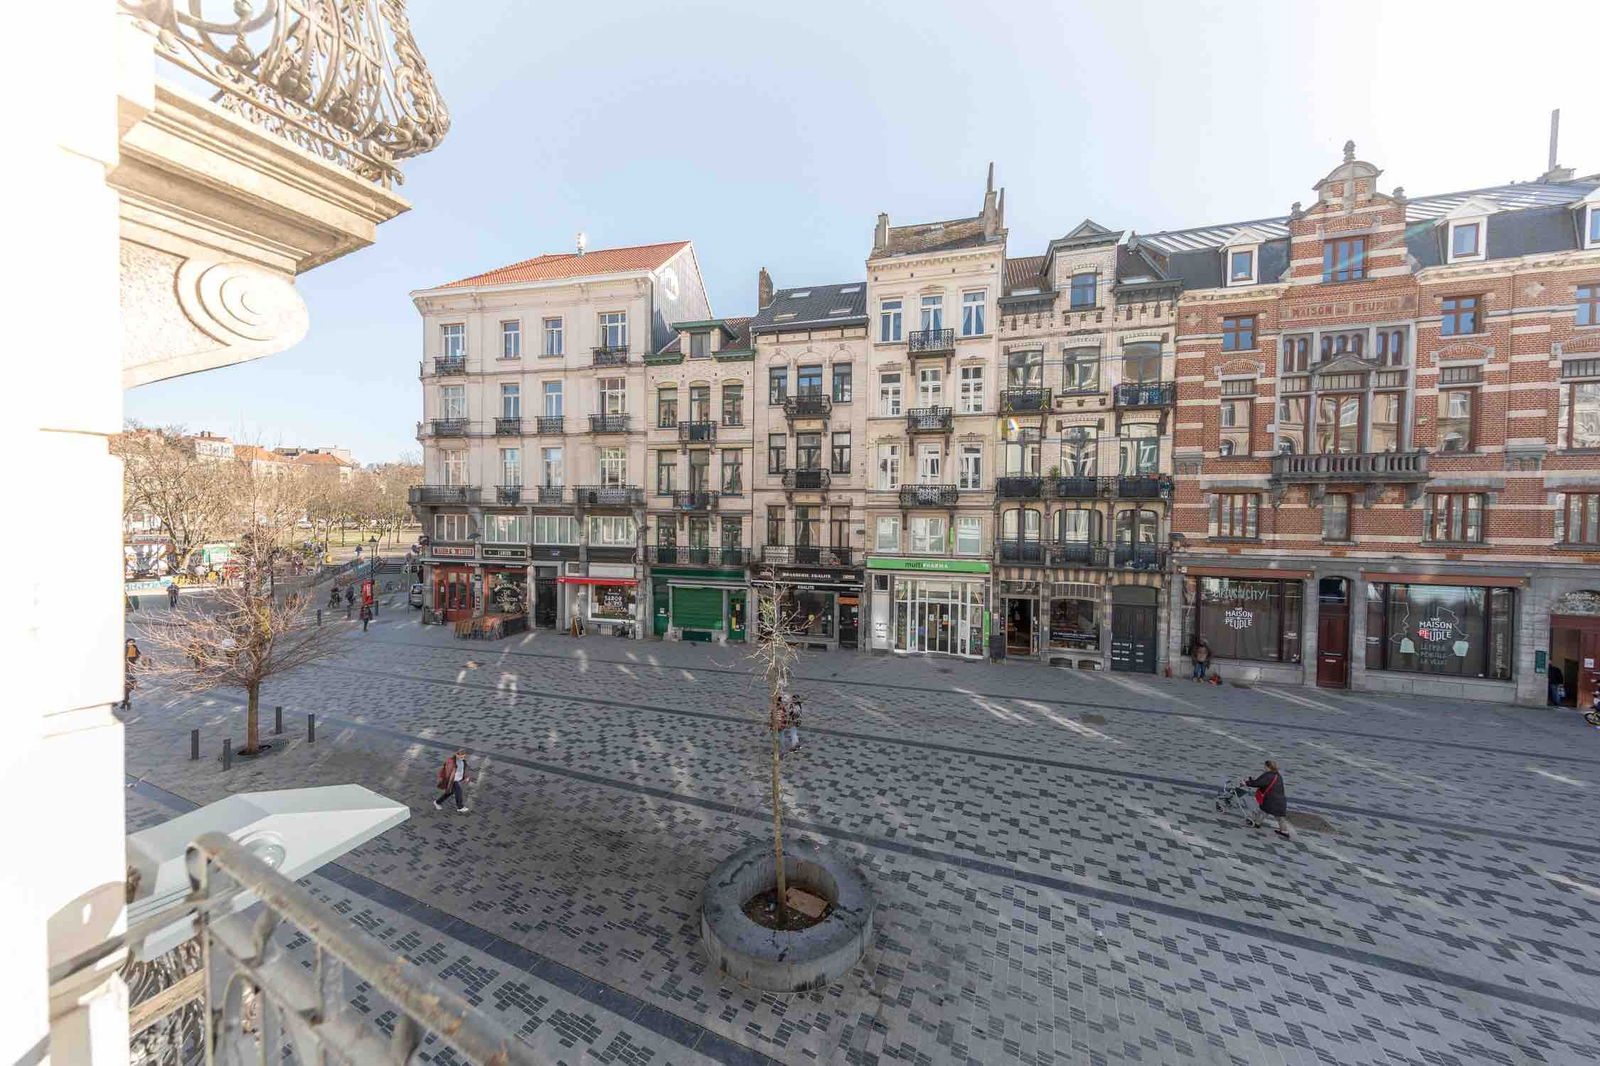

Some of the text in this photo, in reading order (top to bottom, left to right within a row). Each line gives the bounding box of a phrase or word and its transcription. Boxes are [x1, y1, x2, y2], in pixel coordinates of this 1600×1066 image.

[1292, 305, 1332, 318] MAISON
[1225, 618, 1252, 629] PEUPLE
[1418, 621, 1453, 629] MAISON
[1417, 629, 1452, 641] PEUPLE
